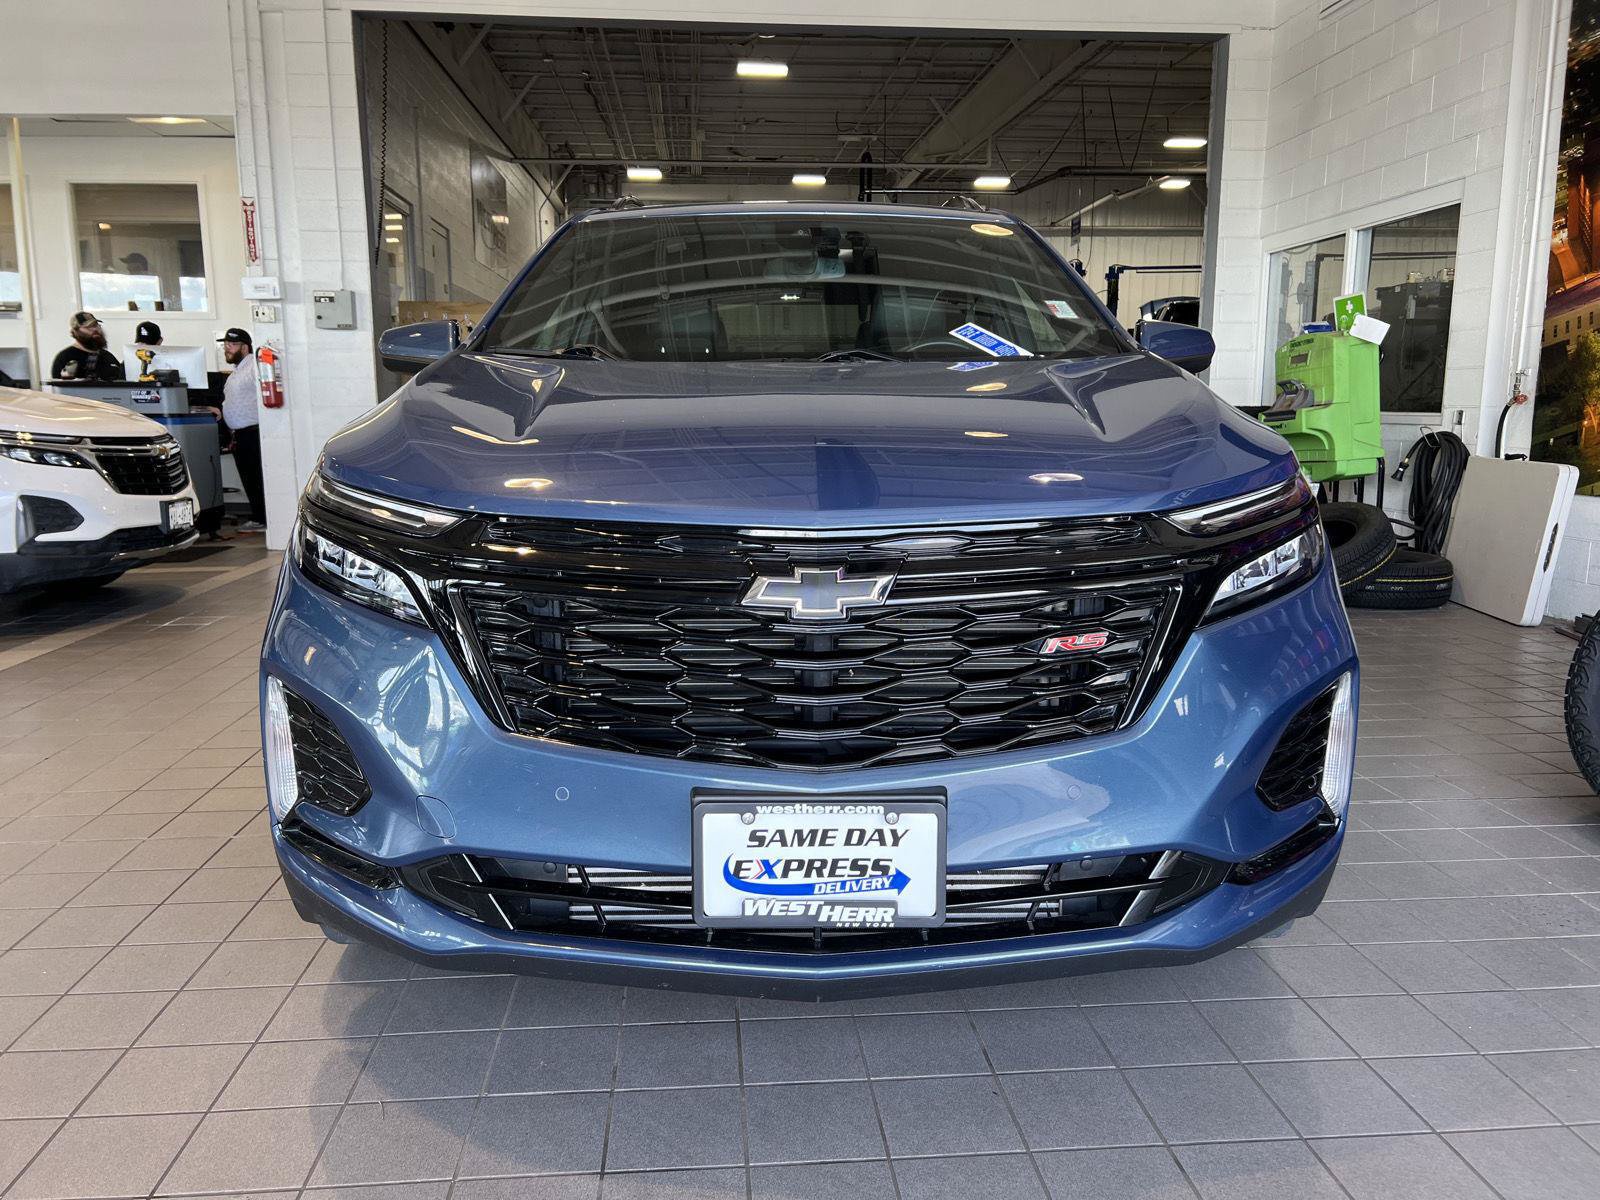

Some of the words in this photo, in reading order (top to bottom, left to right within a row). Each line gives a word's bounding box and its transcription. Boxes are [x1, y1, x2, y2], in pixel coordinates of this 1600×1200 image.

[1039, 631, 1109, 654] RS
[756, 804, 885, 814] westherr.com
[747, 828, 838, 848] SAME
[844, 828, 909, 848] DAY
[732, 858, 893, 879] EXPRESS
[813, 876, 894, 895] DELIVERY
